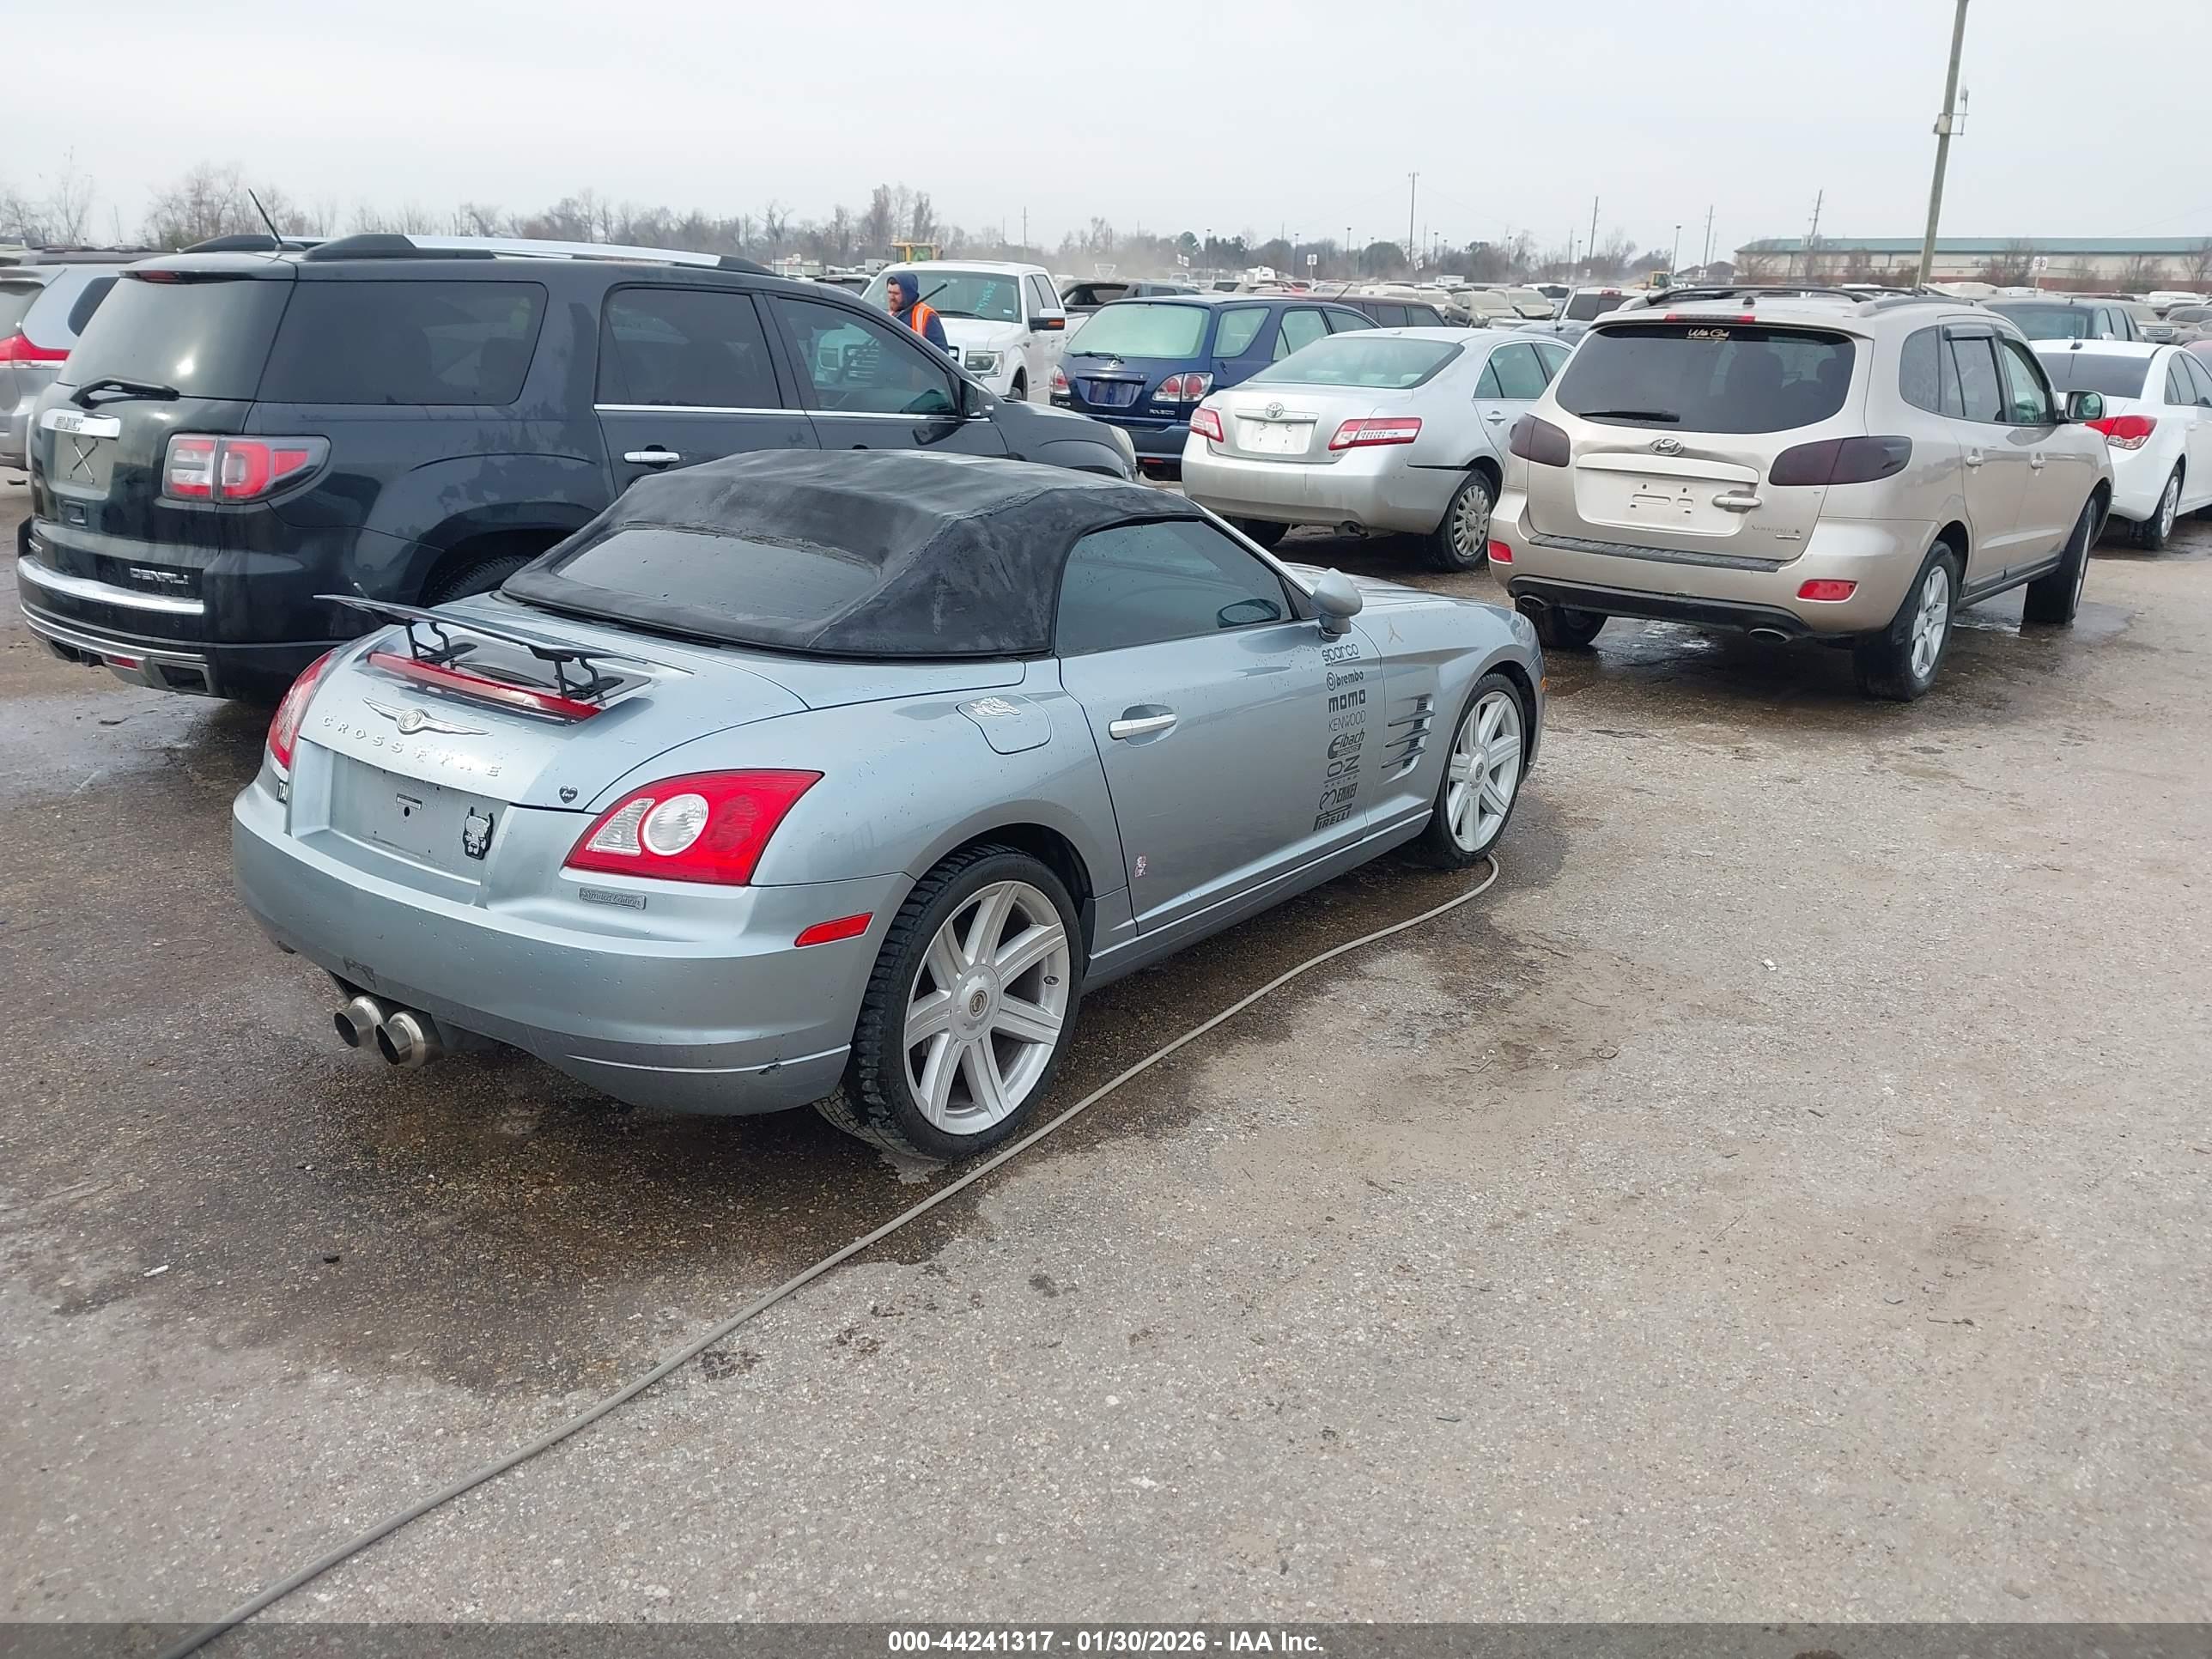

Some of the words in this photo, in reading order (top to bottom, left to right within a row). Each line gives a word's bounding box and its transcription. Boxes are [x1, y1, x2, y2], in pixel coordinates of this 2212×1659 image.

[54, 416, 83, 432] GMC
[130, 568, 189, 585] DENALI
[1322, 643, 1360, 666] sparco
[1334, 668, 1364, 687] brembo
[1328, 710, 1366, 732] KENWOOD
[1328, 727, 1365, 760] Eibach
[1312, 803, 1352, 832] PIRELLI
